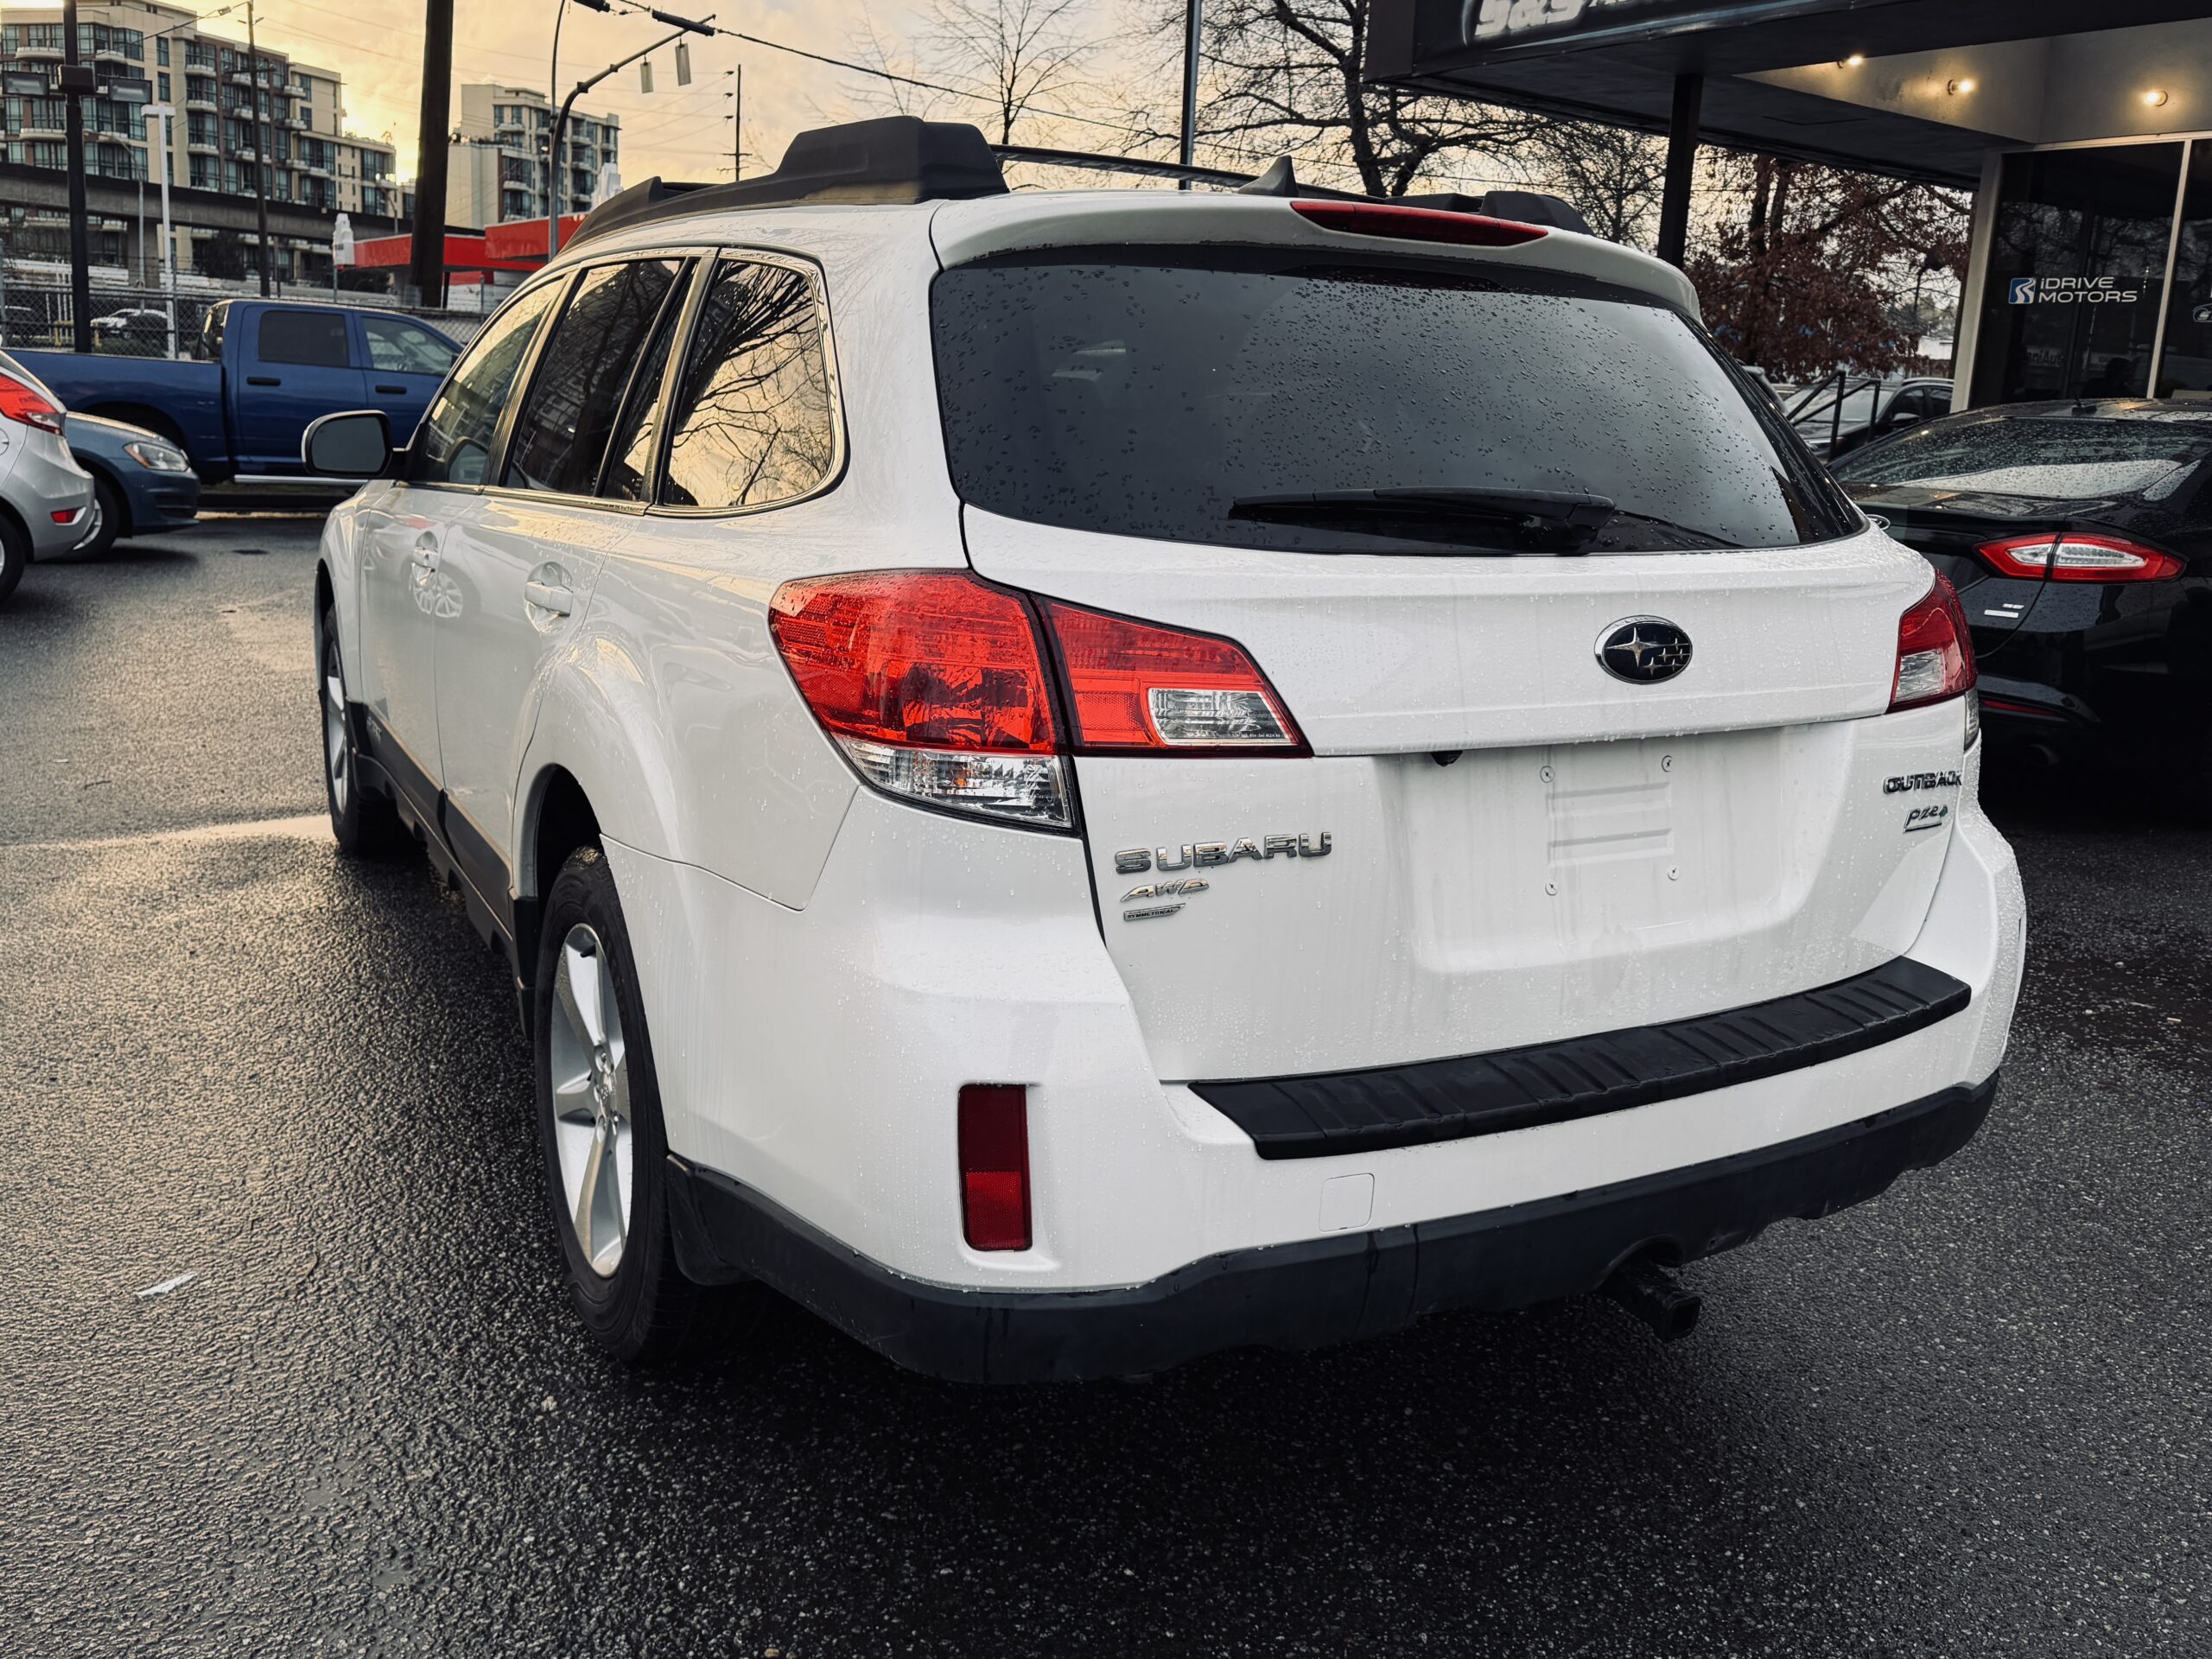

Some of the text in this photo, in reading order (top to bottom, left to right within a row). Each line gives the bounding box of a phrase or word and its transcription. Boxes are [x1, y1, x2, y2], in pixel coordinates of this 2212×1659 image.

[2040, 276, 2114, 289] iDRIVE
[2038, 290, 2138, 303] MOTORS
[1884, 771, 1962, 794] OUTBACK
[1115, 831, 1332, 874] SUBARU
[1121, 878, 1210, 902] AWD
